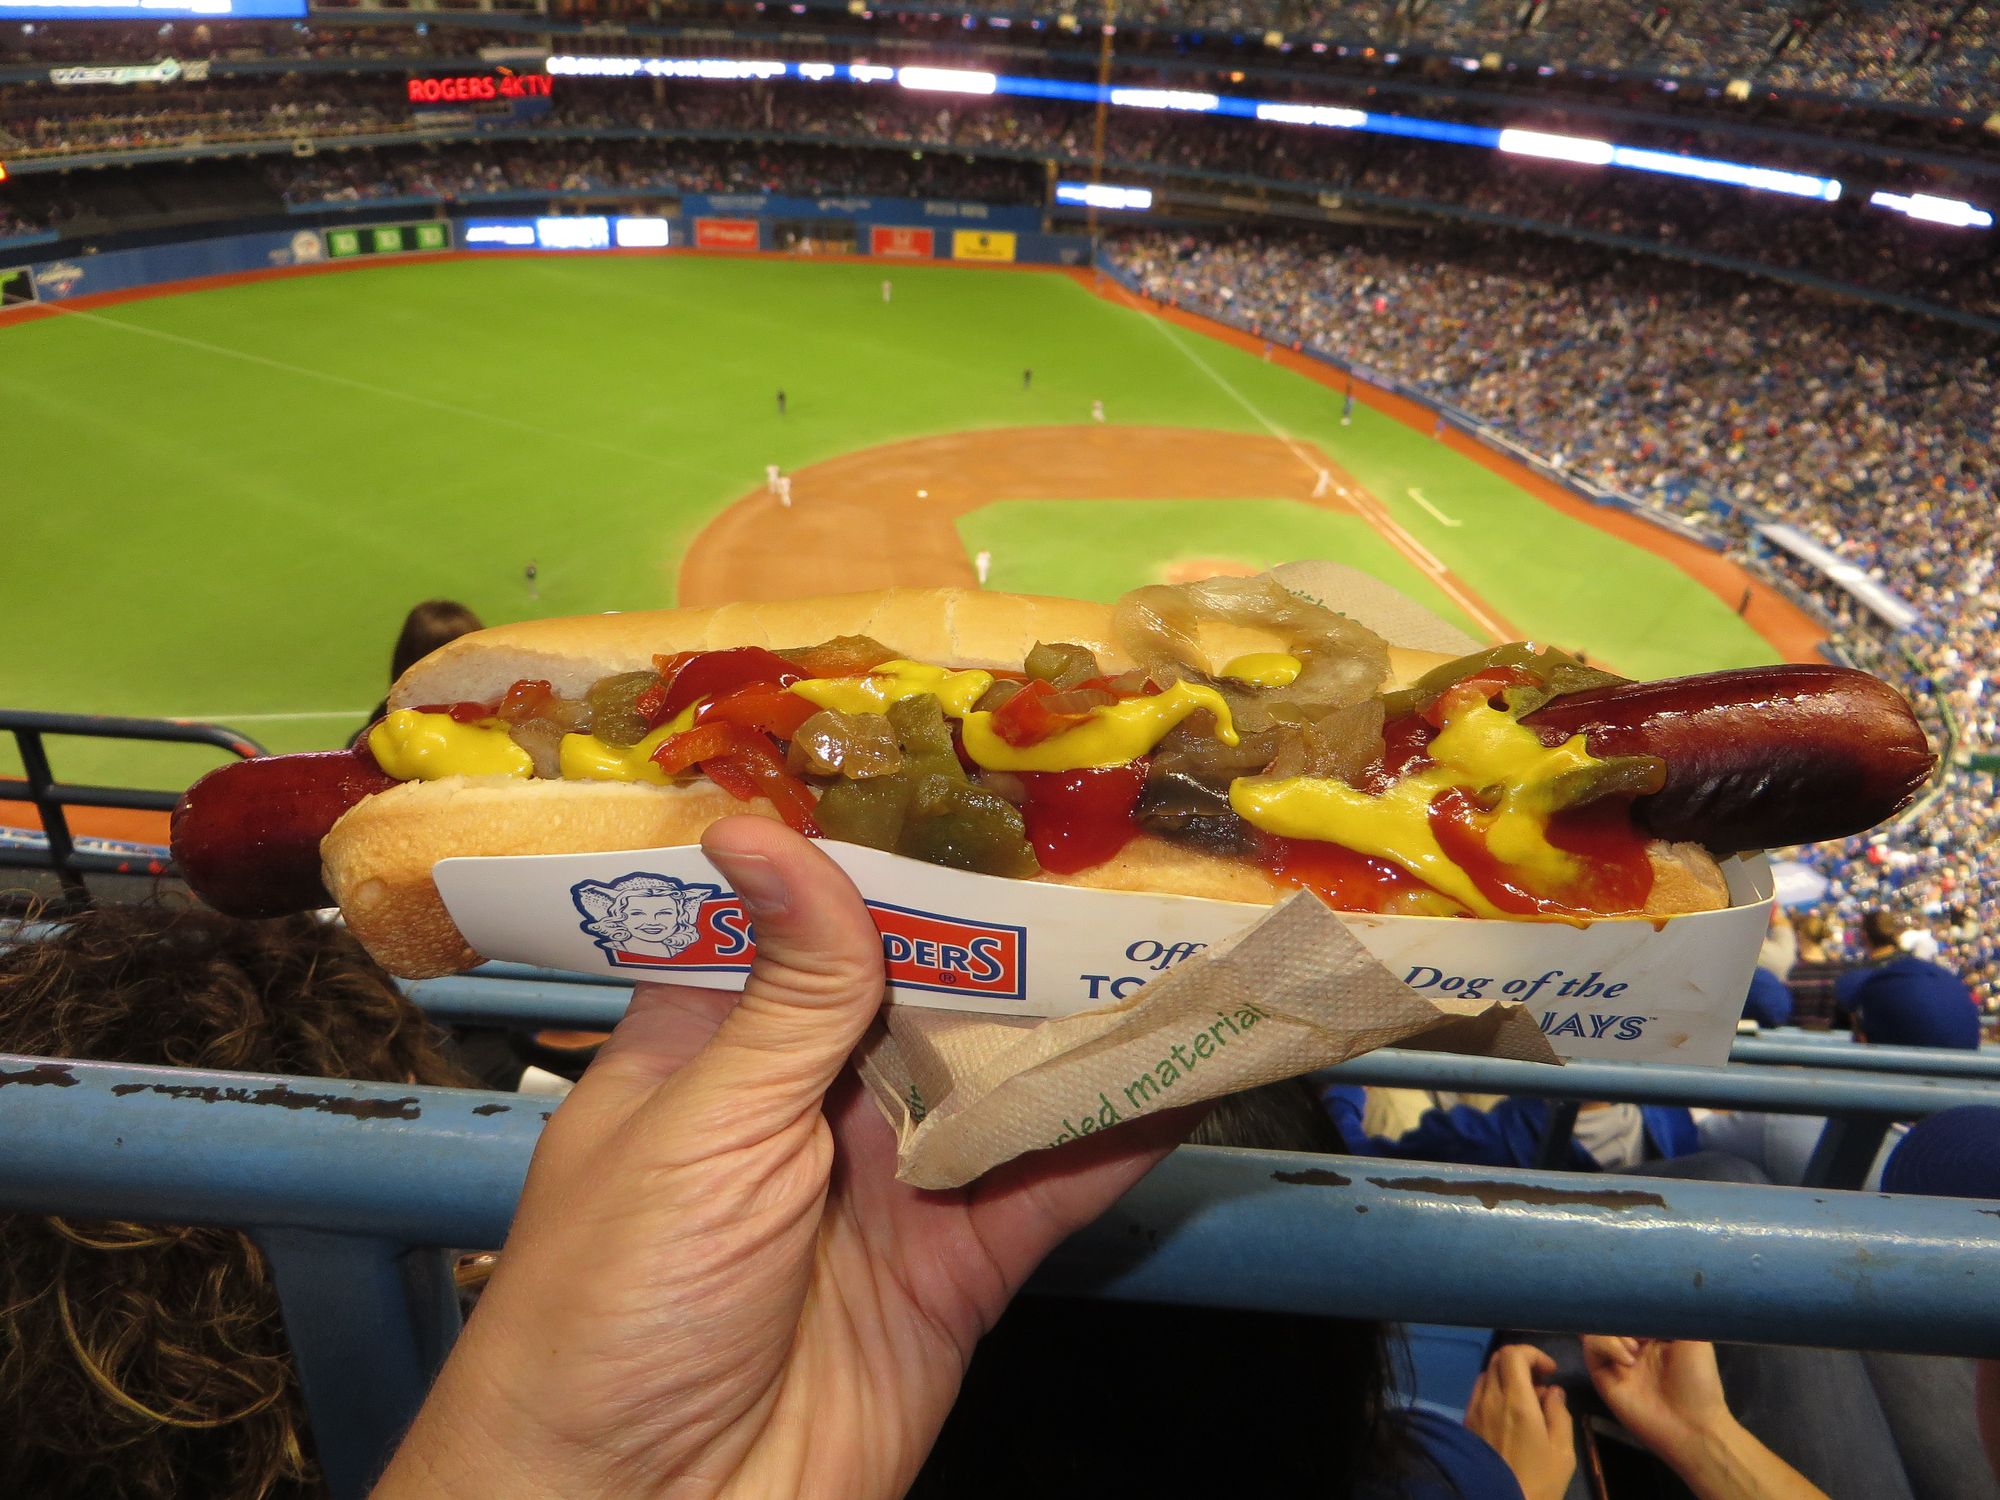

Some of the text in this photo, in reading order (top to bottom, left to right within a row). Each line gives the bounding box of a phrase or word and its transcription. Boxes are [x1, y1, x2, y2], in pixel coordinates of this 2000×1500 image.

[407, 77, 496, 103] ROGERS
[710, 907, 1005, 983] SDERS
[1403, 965, 1629, 1002] Dog of the
[1539, 1011, 1648, 1041] JAYS
[1123, 1002, 1272, 1109] material
